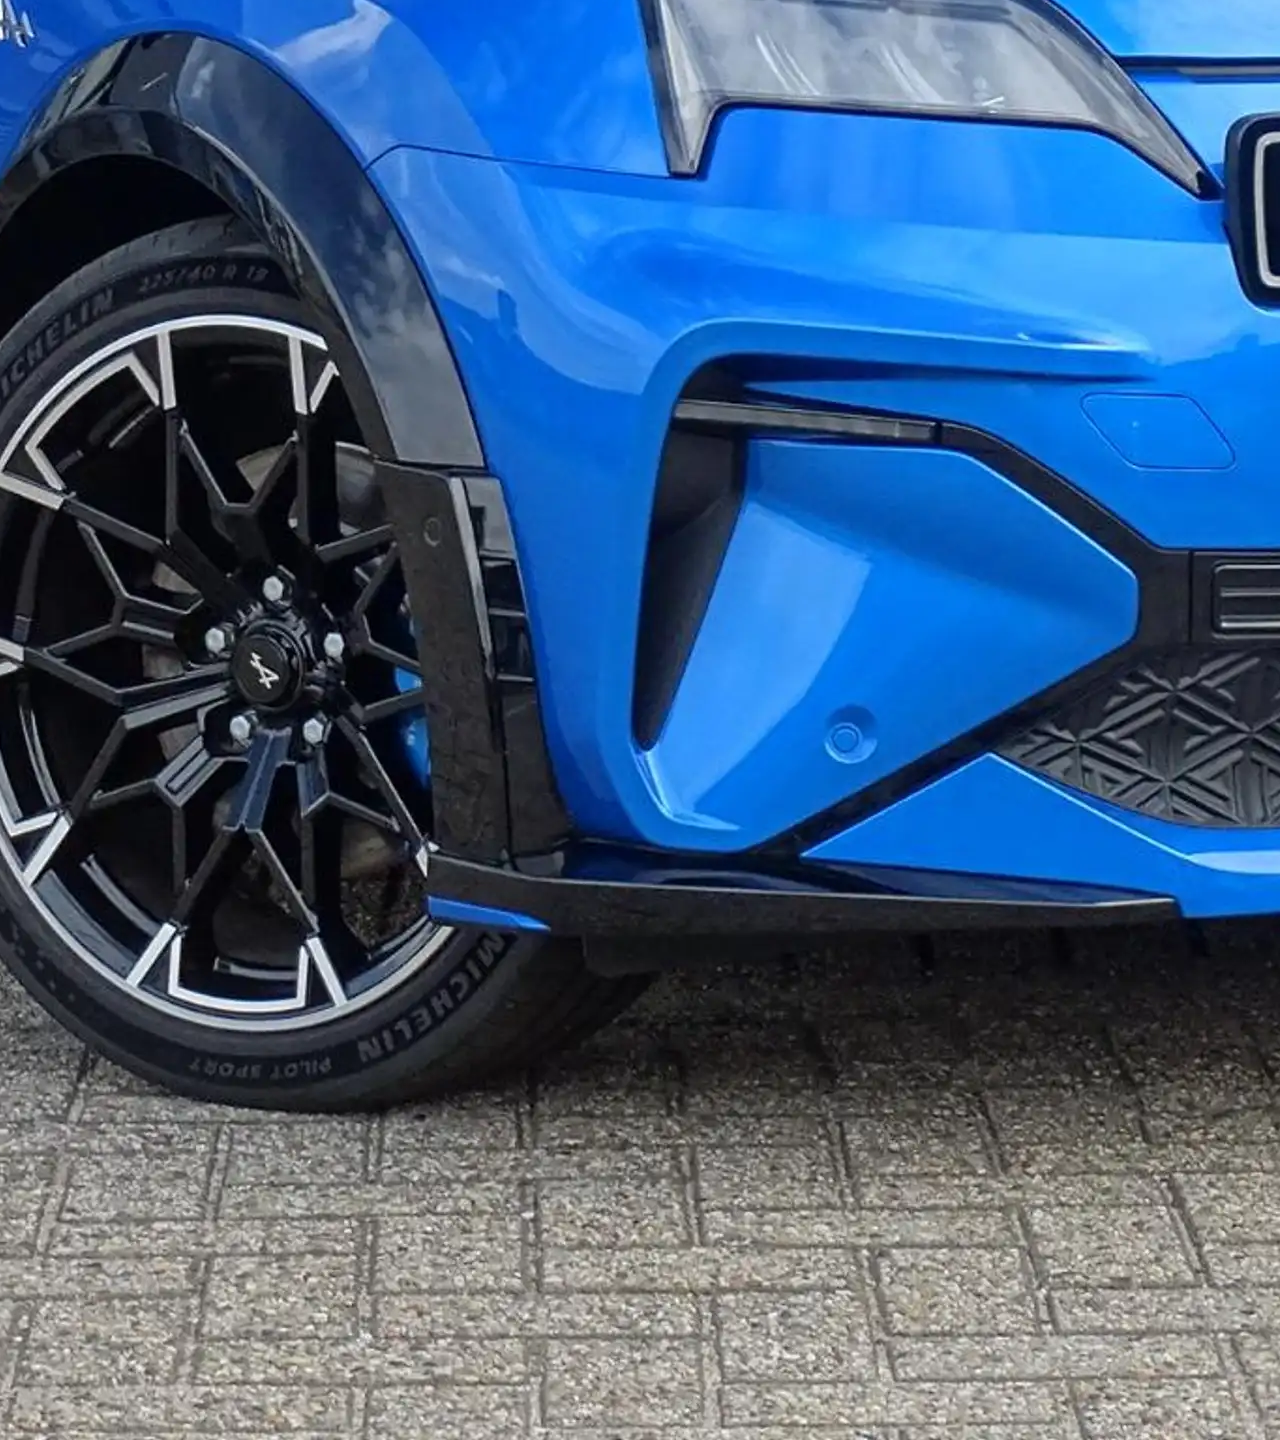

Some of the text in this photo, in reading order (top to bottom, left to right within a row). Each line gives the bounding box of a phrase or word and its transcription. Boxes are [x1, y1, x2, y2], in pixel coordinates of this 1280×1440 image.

[188, 932, 506, 1081] MICHELIN PILOT SPORT
